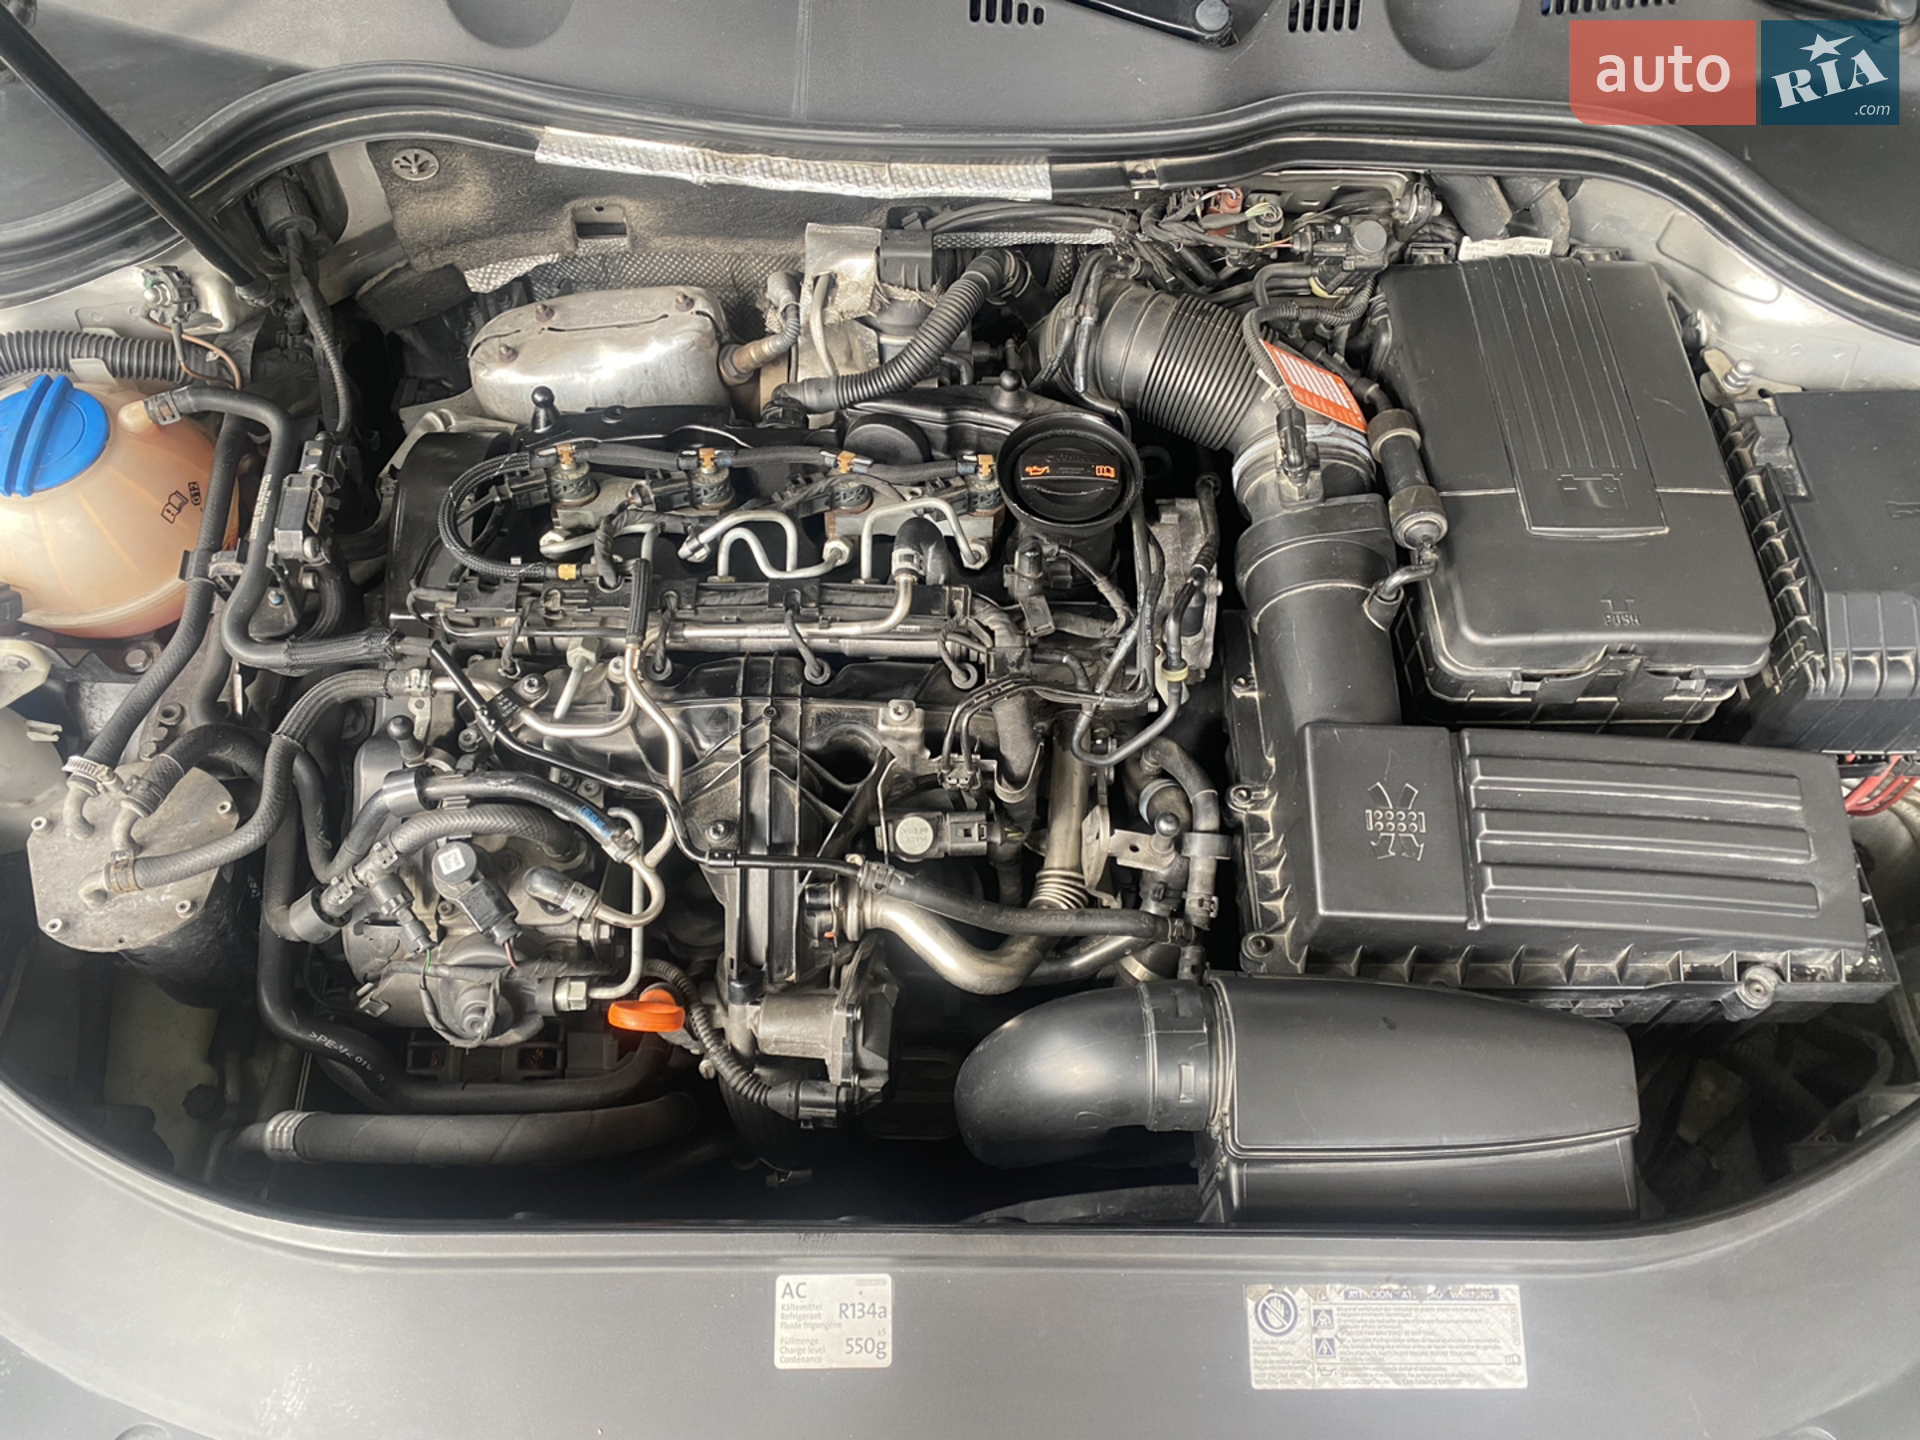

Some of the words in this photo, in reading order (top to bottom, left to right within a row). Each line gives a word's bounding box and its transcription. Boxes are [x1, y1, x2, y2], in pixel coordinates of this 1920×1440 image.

[1603, 613, 1641, 627] PUSH
[781, 1282, 807, 1299] AC
[839, 1302, 887, 1320] R134a
[845, 1337, 887, 1360] 550g
